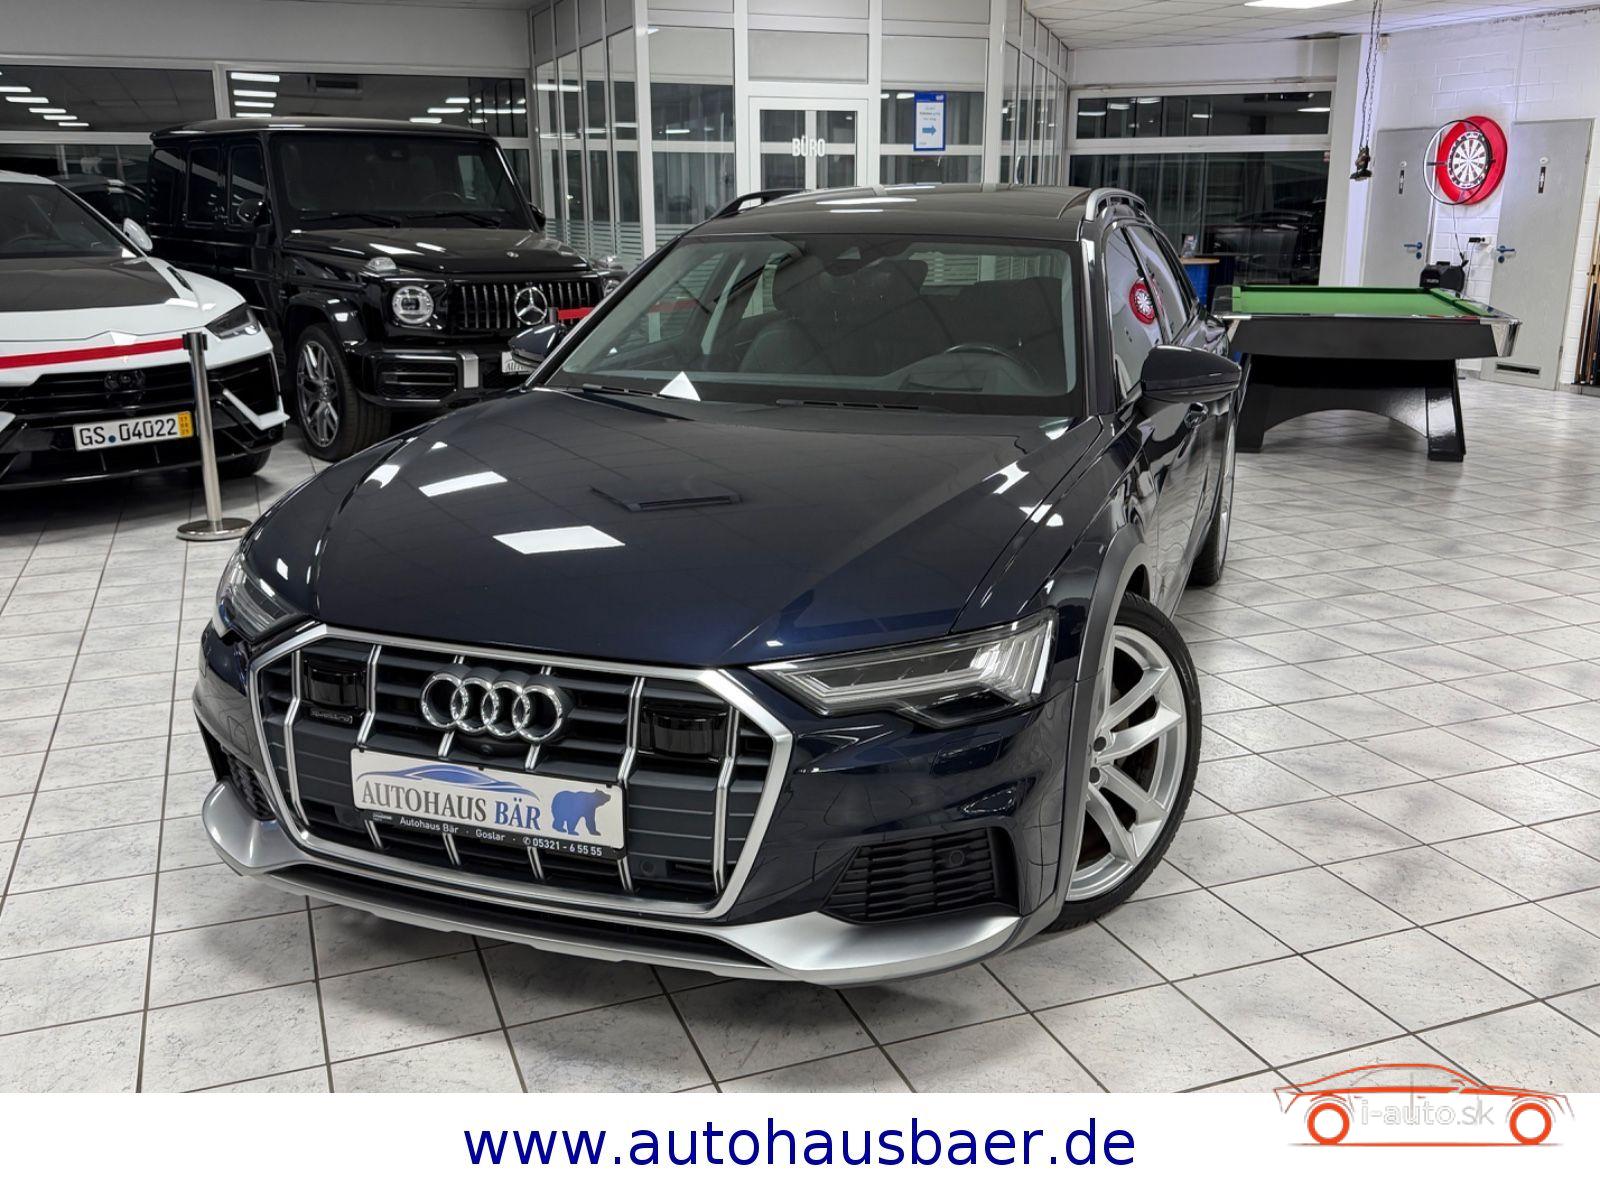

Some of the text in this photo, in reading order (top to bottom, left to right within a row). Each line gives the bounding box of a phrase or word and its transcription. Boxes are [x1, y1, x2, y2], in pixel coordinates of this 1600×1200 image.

[792, 135, 826, 157] BÜRO
[79, 426, 106, 446] GS
[119, 418, 177, 441] 04022
[362, 781, 541, 831] AUTOHAUS BÄR
[400, 816, 440, 830] Autohaus
[475, 828, 506, 841] Goslar
[532, 838, 560, 850] 05321
